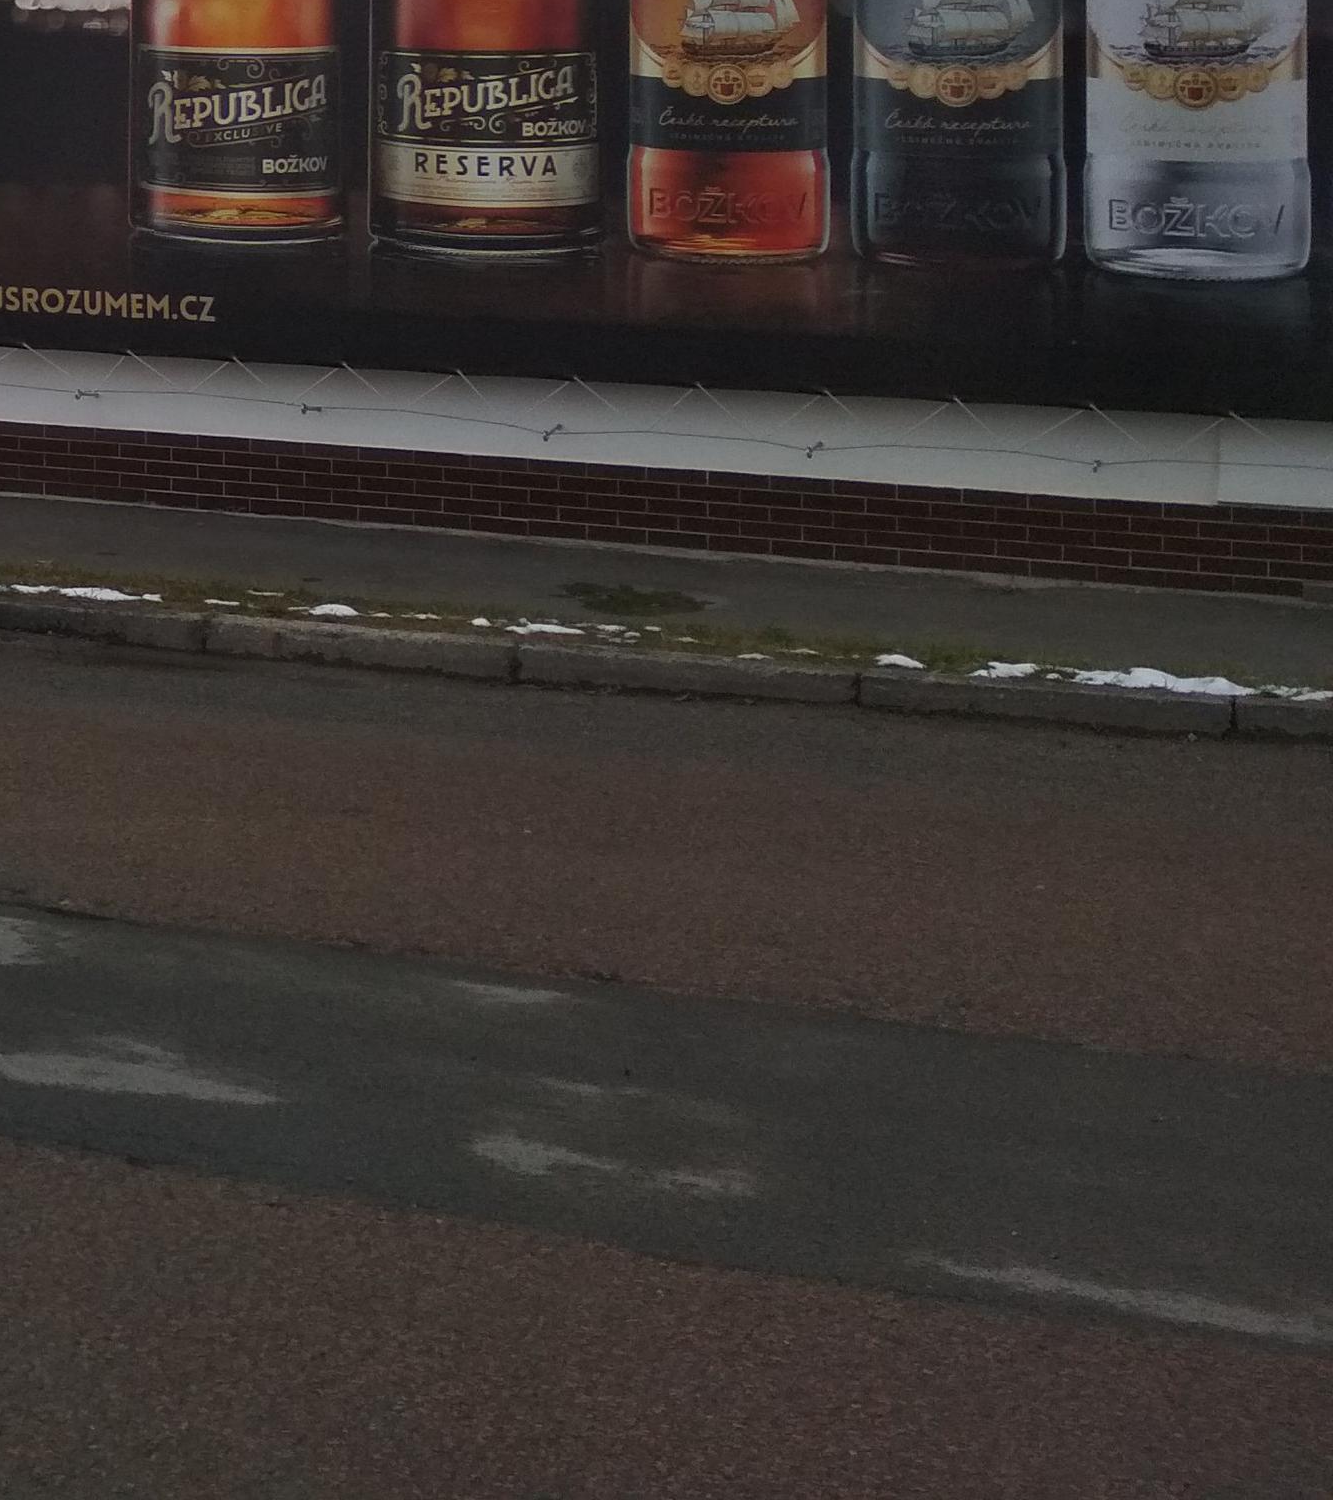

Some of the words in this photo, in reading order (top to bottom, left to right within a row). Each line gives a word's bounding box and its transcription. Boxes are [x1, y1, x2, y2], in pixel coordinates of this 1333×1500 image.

[521, 118, 587, 138] BOŽKOV
[262, 155, 329, 175] BOŽKOV
[414, 152, 558, 178] RESERVA
